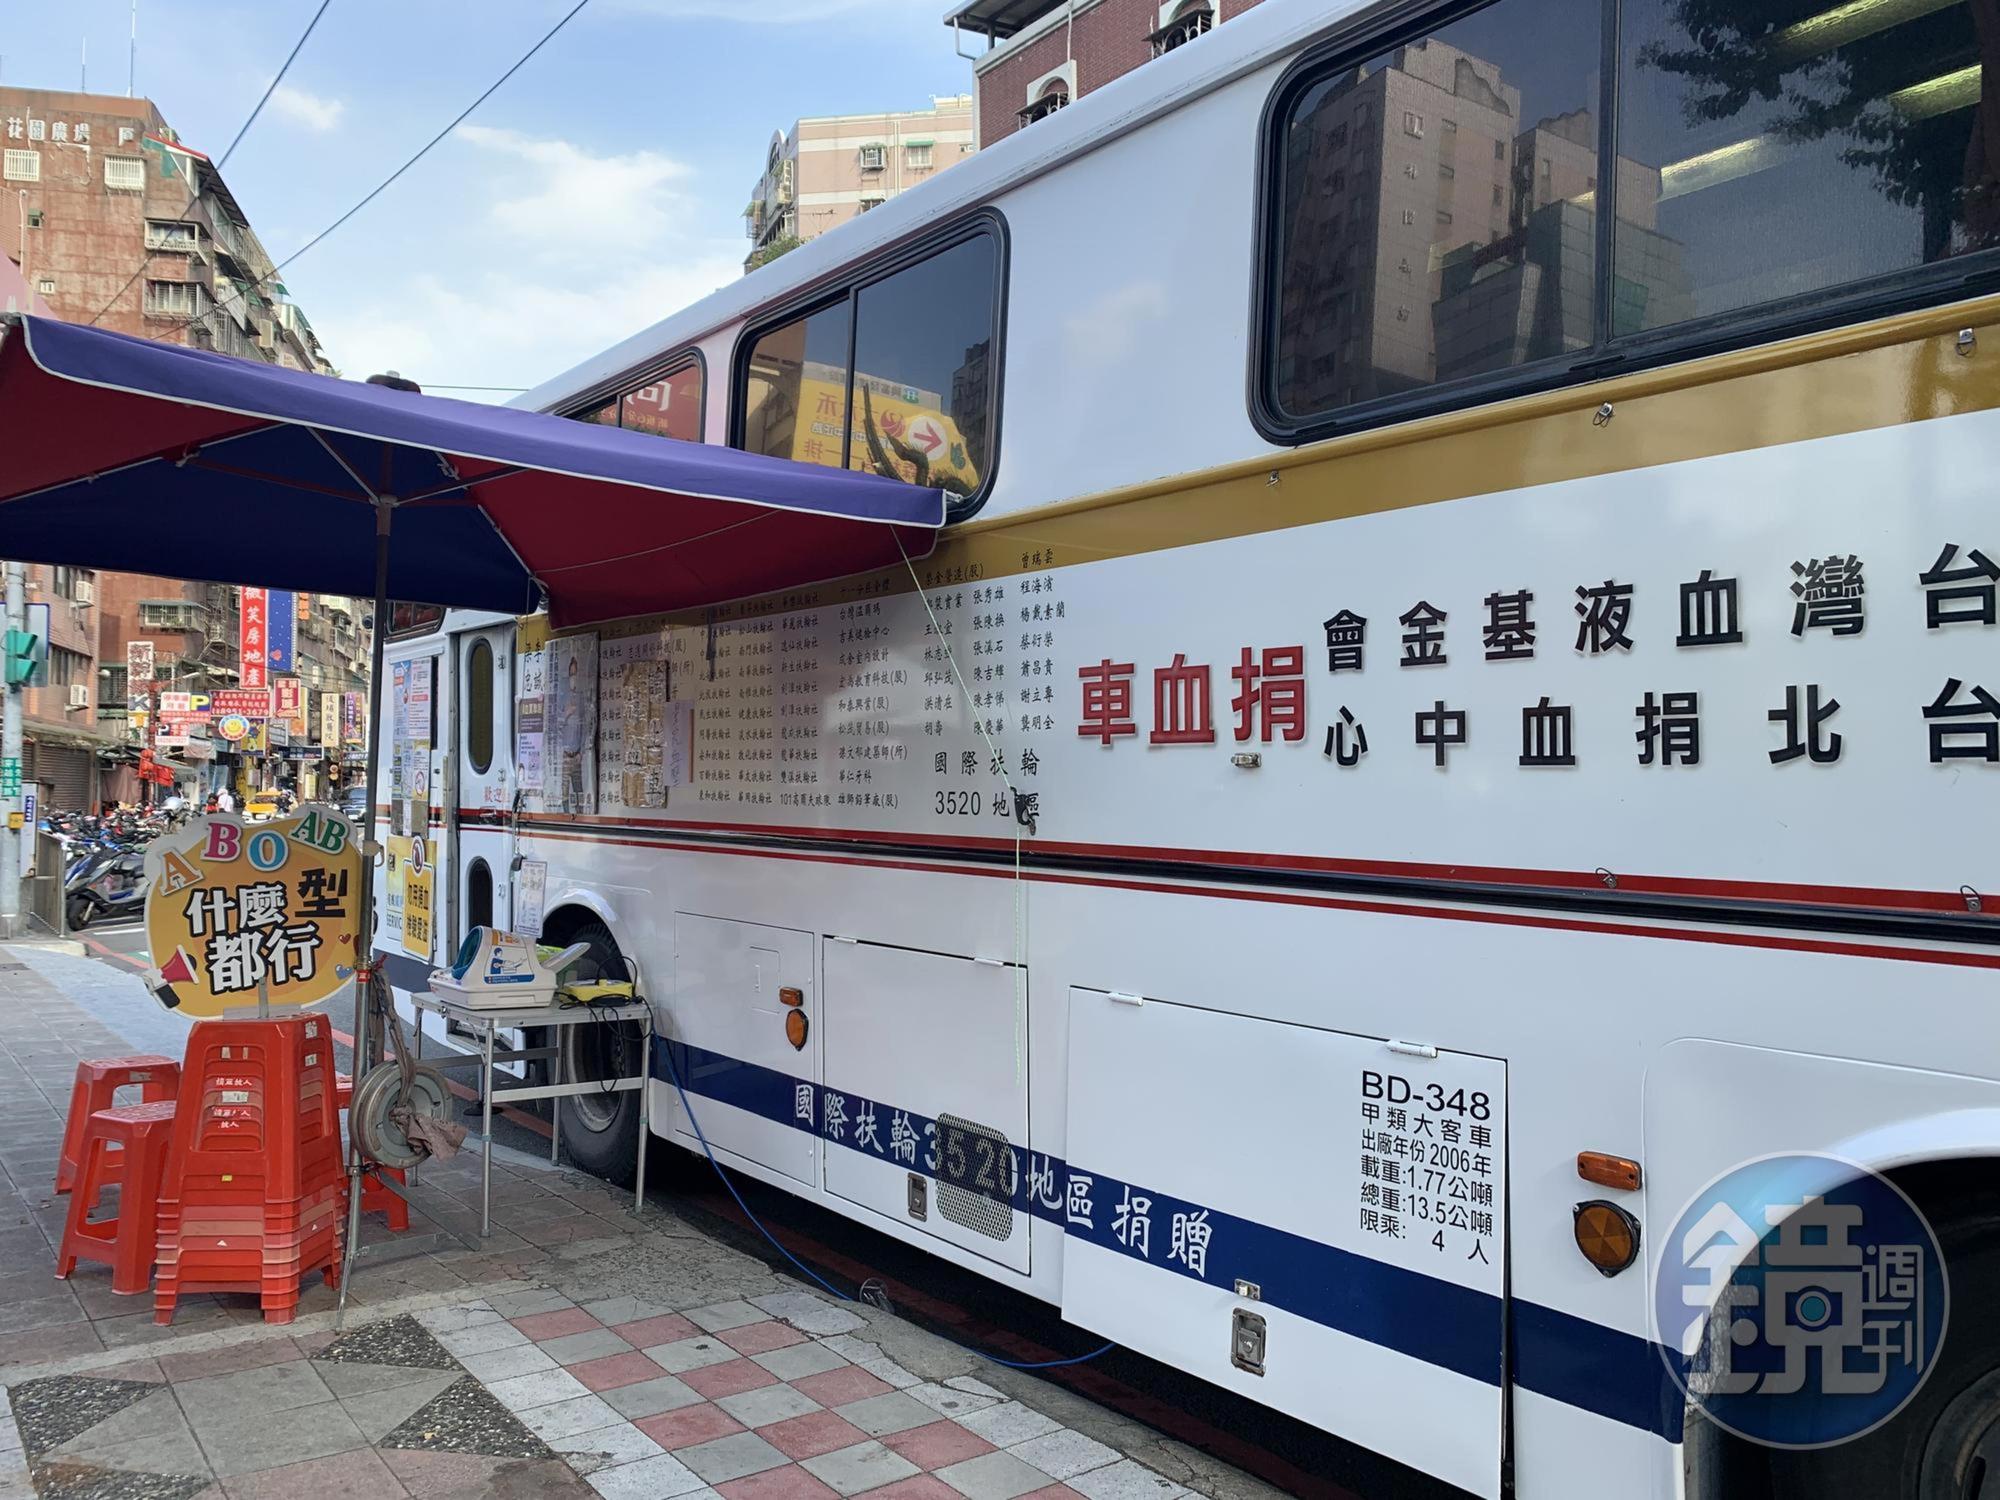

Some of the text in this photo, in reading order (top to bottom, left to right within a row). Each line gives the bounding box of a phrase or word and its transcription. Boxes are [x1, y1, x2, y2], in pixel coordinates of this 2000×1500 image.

[191, 694, 210, 711] P
[934, 747, 1041, 777] 國際扶輪
[935, 790, 981, 816] 3520
[160, 810, 348, 896] A B O AB
[207, 920, 322, 995] 都行
[1362, 1070, 1491, 1121] BD-348
[1362, 1102, 1492, 1149] 甲類大客車
[1431, 1229, 1445, 1252] 4
[1467, 1238, 1490, 1266] 人
